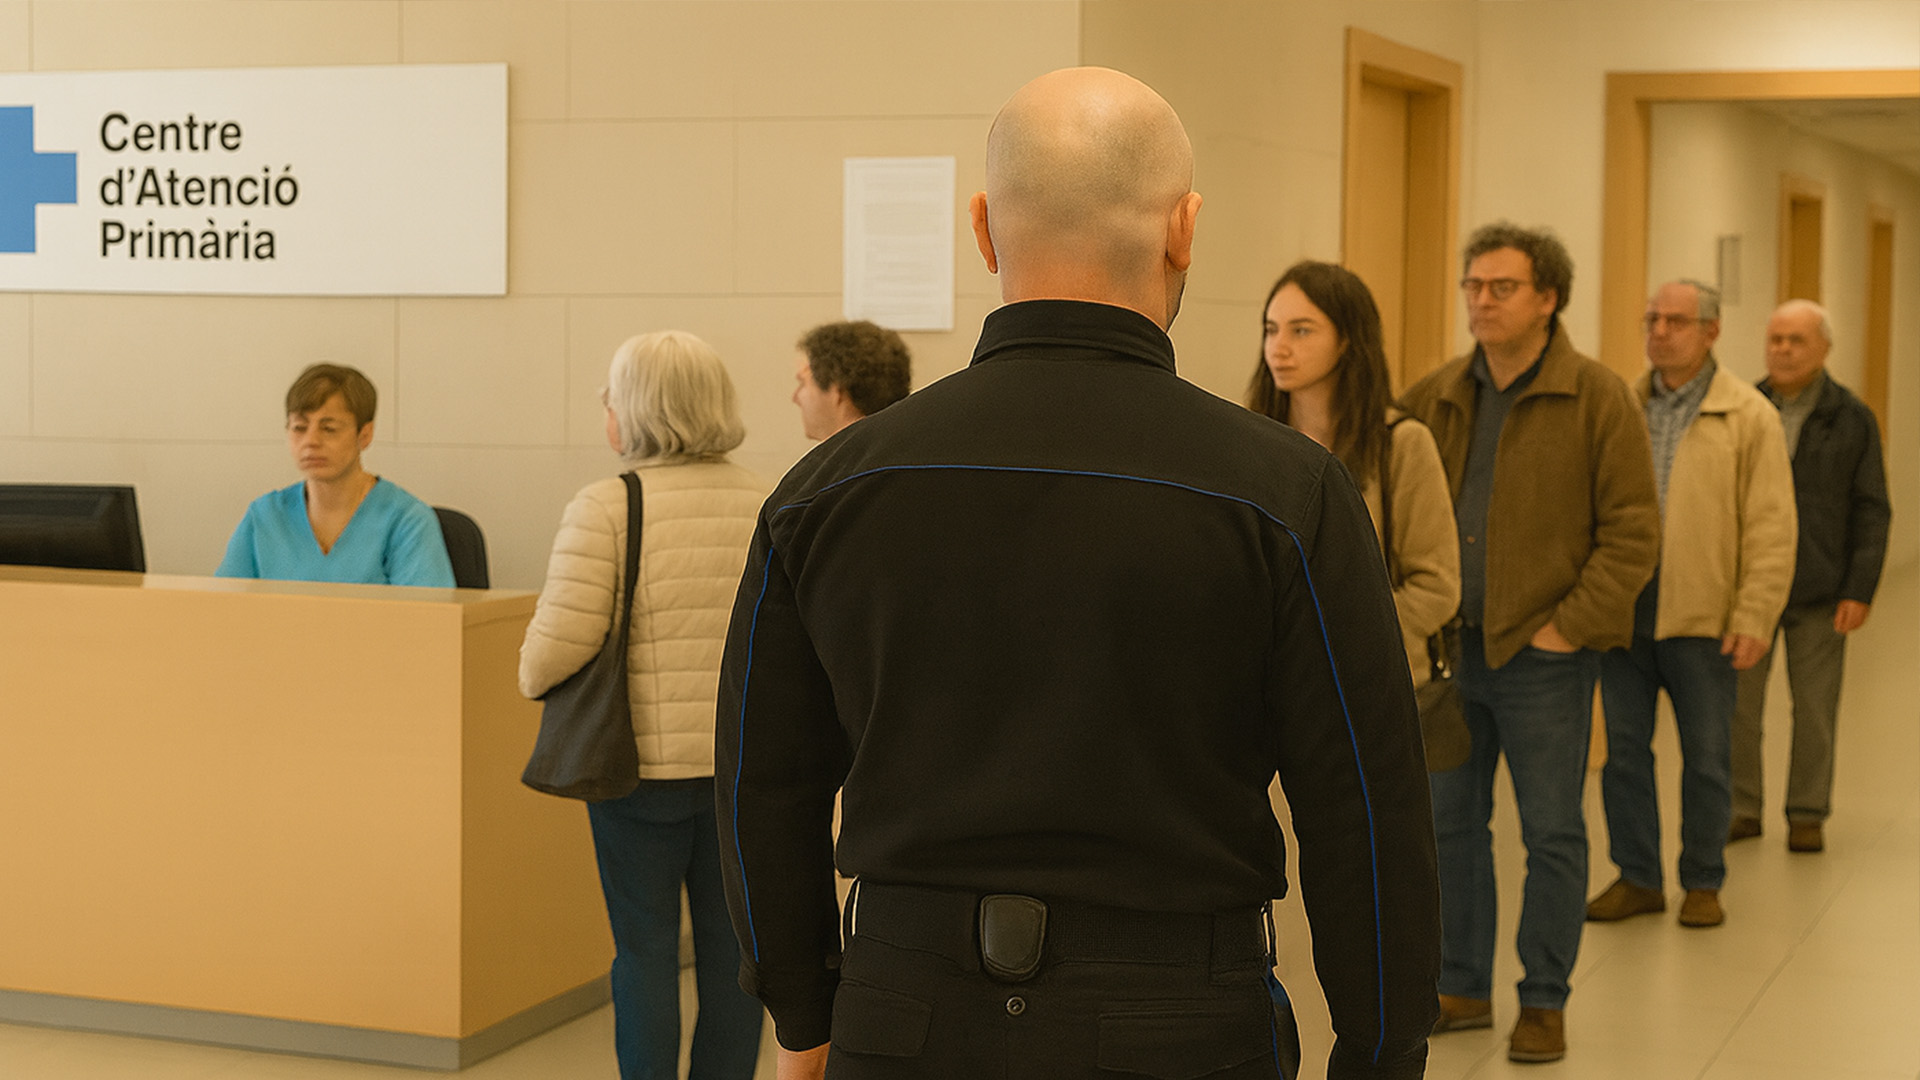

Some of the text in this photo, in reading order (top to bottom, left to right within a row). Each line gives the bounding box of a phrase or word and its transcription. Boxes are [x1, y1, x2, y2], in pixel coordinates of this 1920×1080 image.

[100, 112, 242, 152] Centre
[100, 165, 299, 207] d'Atenció
[101, 218, 275, 260] Primària
